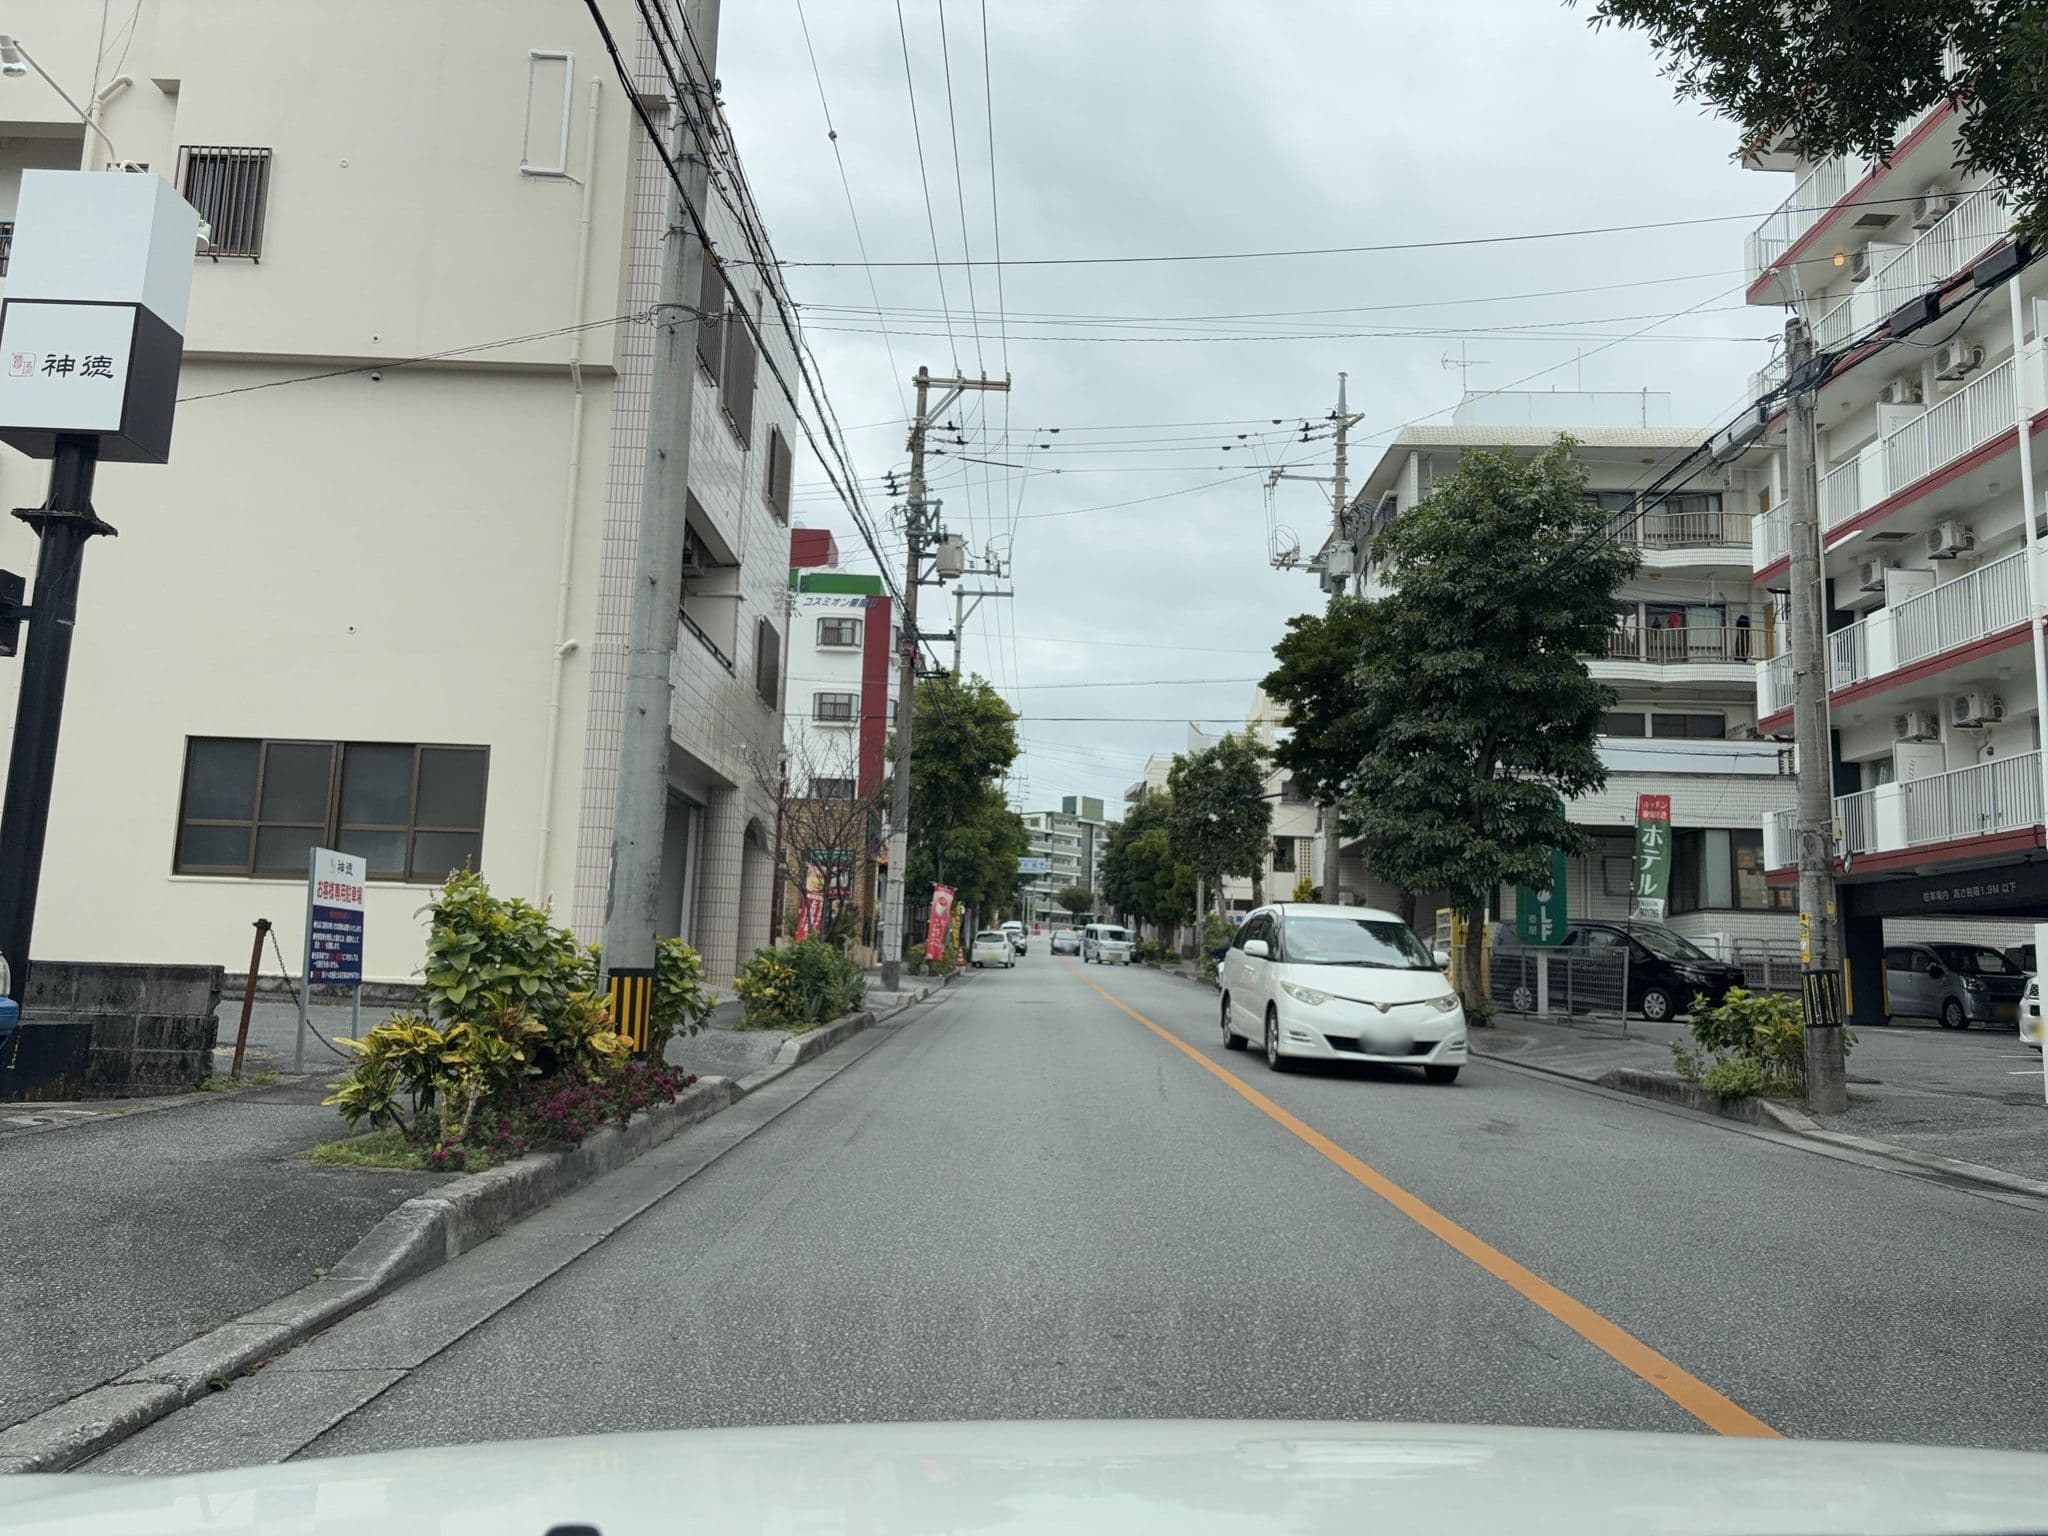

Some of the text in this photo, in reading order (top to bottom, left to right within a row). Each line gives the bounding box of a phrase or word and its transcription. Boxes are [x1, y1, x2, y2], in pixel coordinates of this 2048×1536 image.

[41, 353, 115, 379] 神徳
[1638, 825, 1663, 896] ホテル
